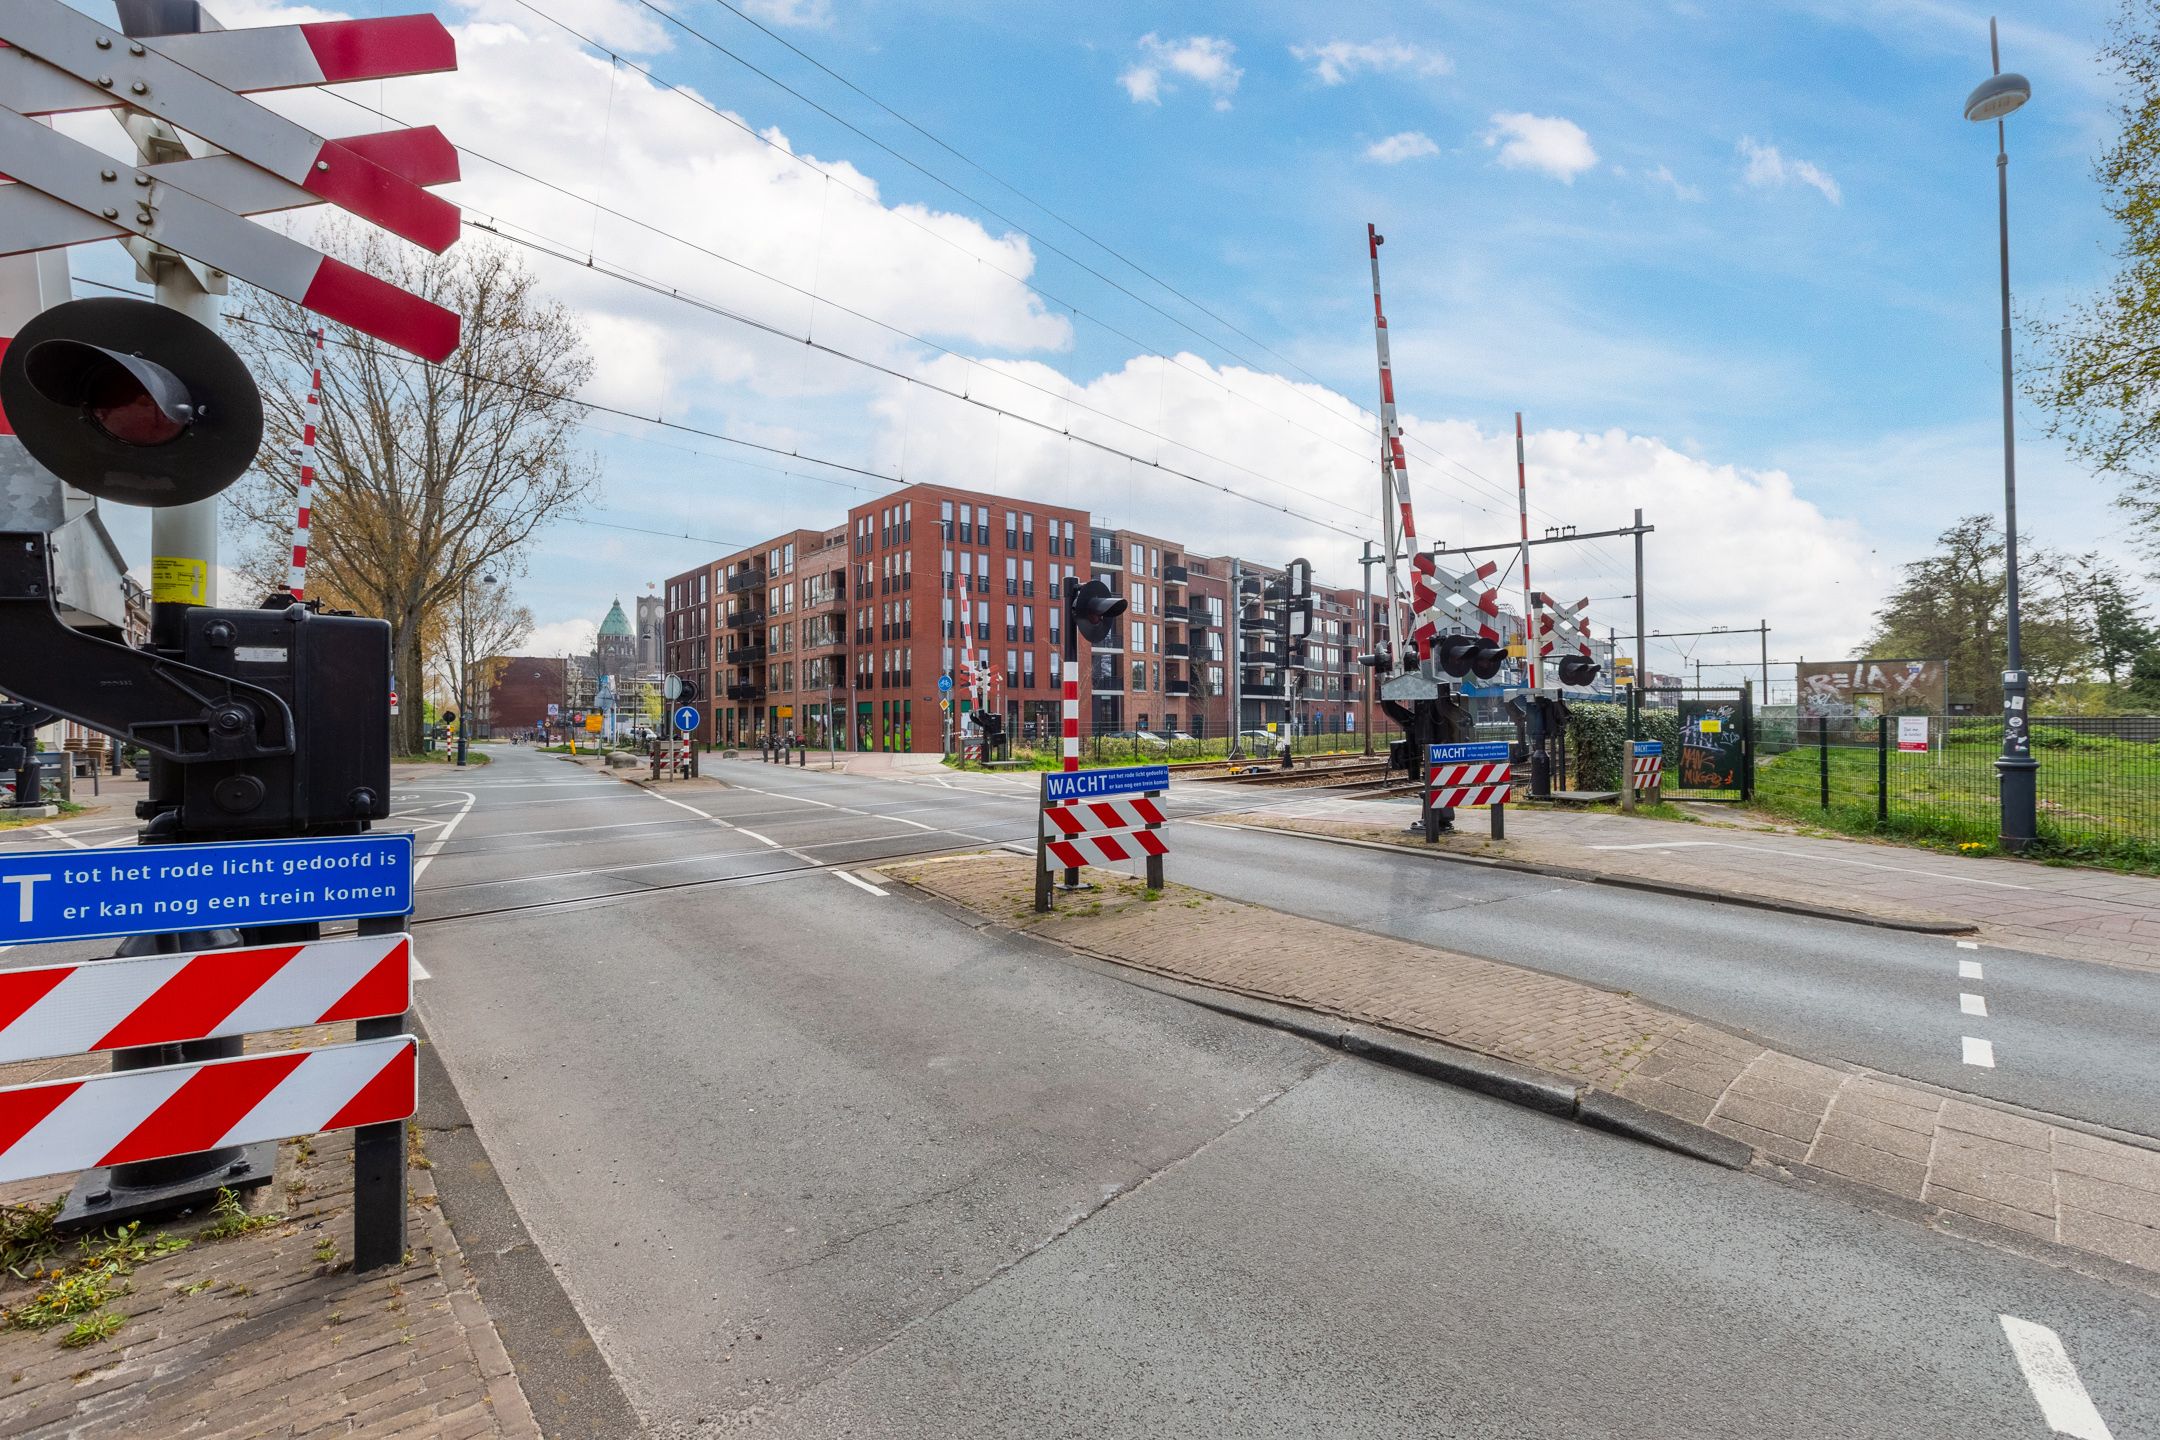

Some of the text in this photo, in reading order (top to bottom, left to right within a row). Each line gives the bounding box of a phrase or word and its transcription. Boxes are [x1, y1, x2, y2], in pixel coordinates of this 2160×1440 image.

[1433, 748, 1466, 759] WACHT
[1049, 775, 1107, 795] WACHT
[64, 851, 396, 884] tot het rode licht gedoofd is
[63, 886, 396, 919] er kan nog een trein komen
